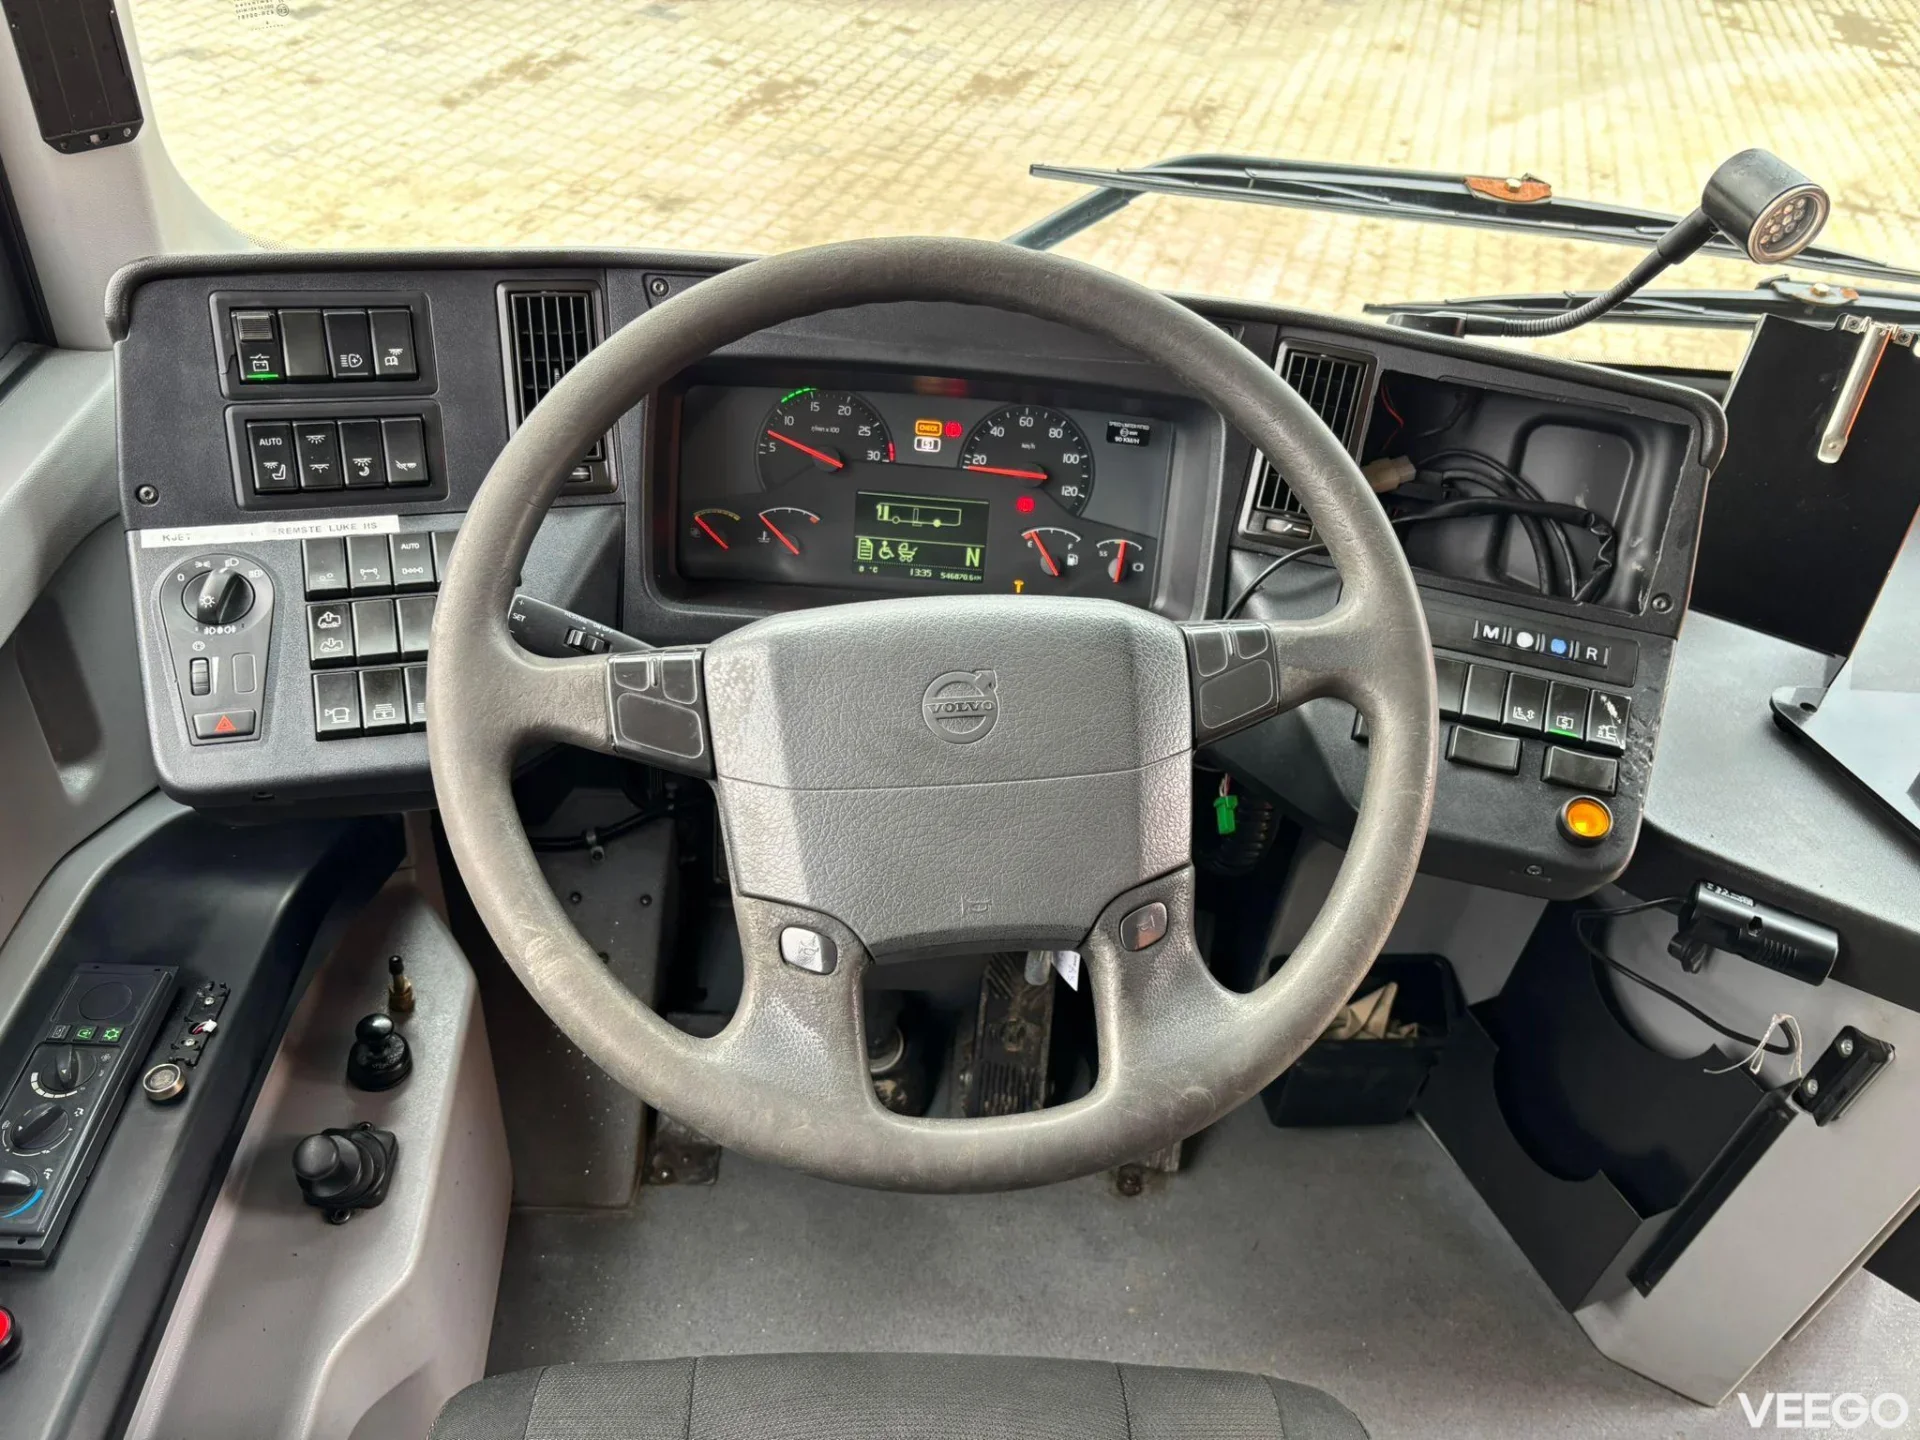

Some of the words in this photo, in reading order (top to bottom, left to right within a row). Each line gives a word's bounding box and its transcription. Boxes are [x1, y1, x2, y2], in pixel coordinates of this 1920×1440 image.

[810, 401, 820, 412] 15
[837, 405, 852, 416] 20
[784, 415, 794, 426] 10
[1019, 416, 1034, 427] 60
[858, 425, 871, 436] 25
[990, 426, 1005, 437] 40
[1048, 428, 1063, 439] 80
[259, 437, 283, 446] AUTO
[769, 442, 776, 452] 5
[866, 450, 881, 461] 30
[972, 454, 987, 465] 20
[1062, 453, 1080, 464] 100
[1061, 485, 1079, 497] 120
[328, 523, 357, 532] LUKE
[401, 542, 420, 550] AUTO
[965, 547, 980, 567] N
[512, 613, 526, 622] SET
[1482, 624, 1500, 640] M
[1585, 646, 1598, 661] R
[924, 701, 995, 714] VOLVO
